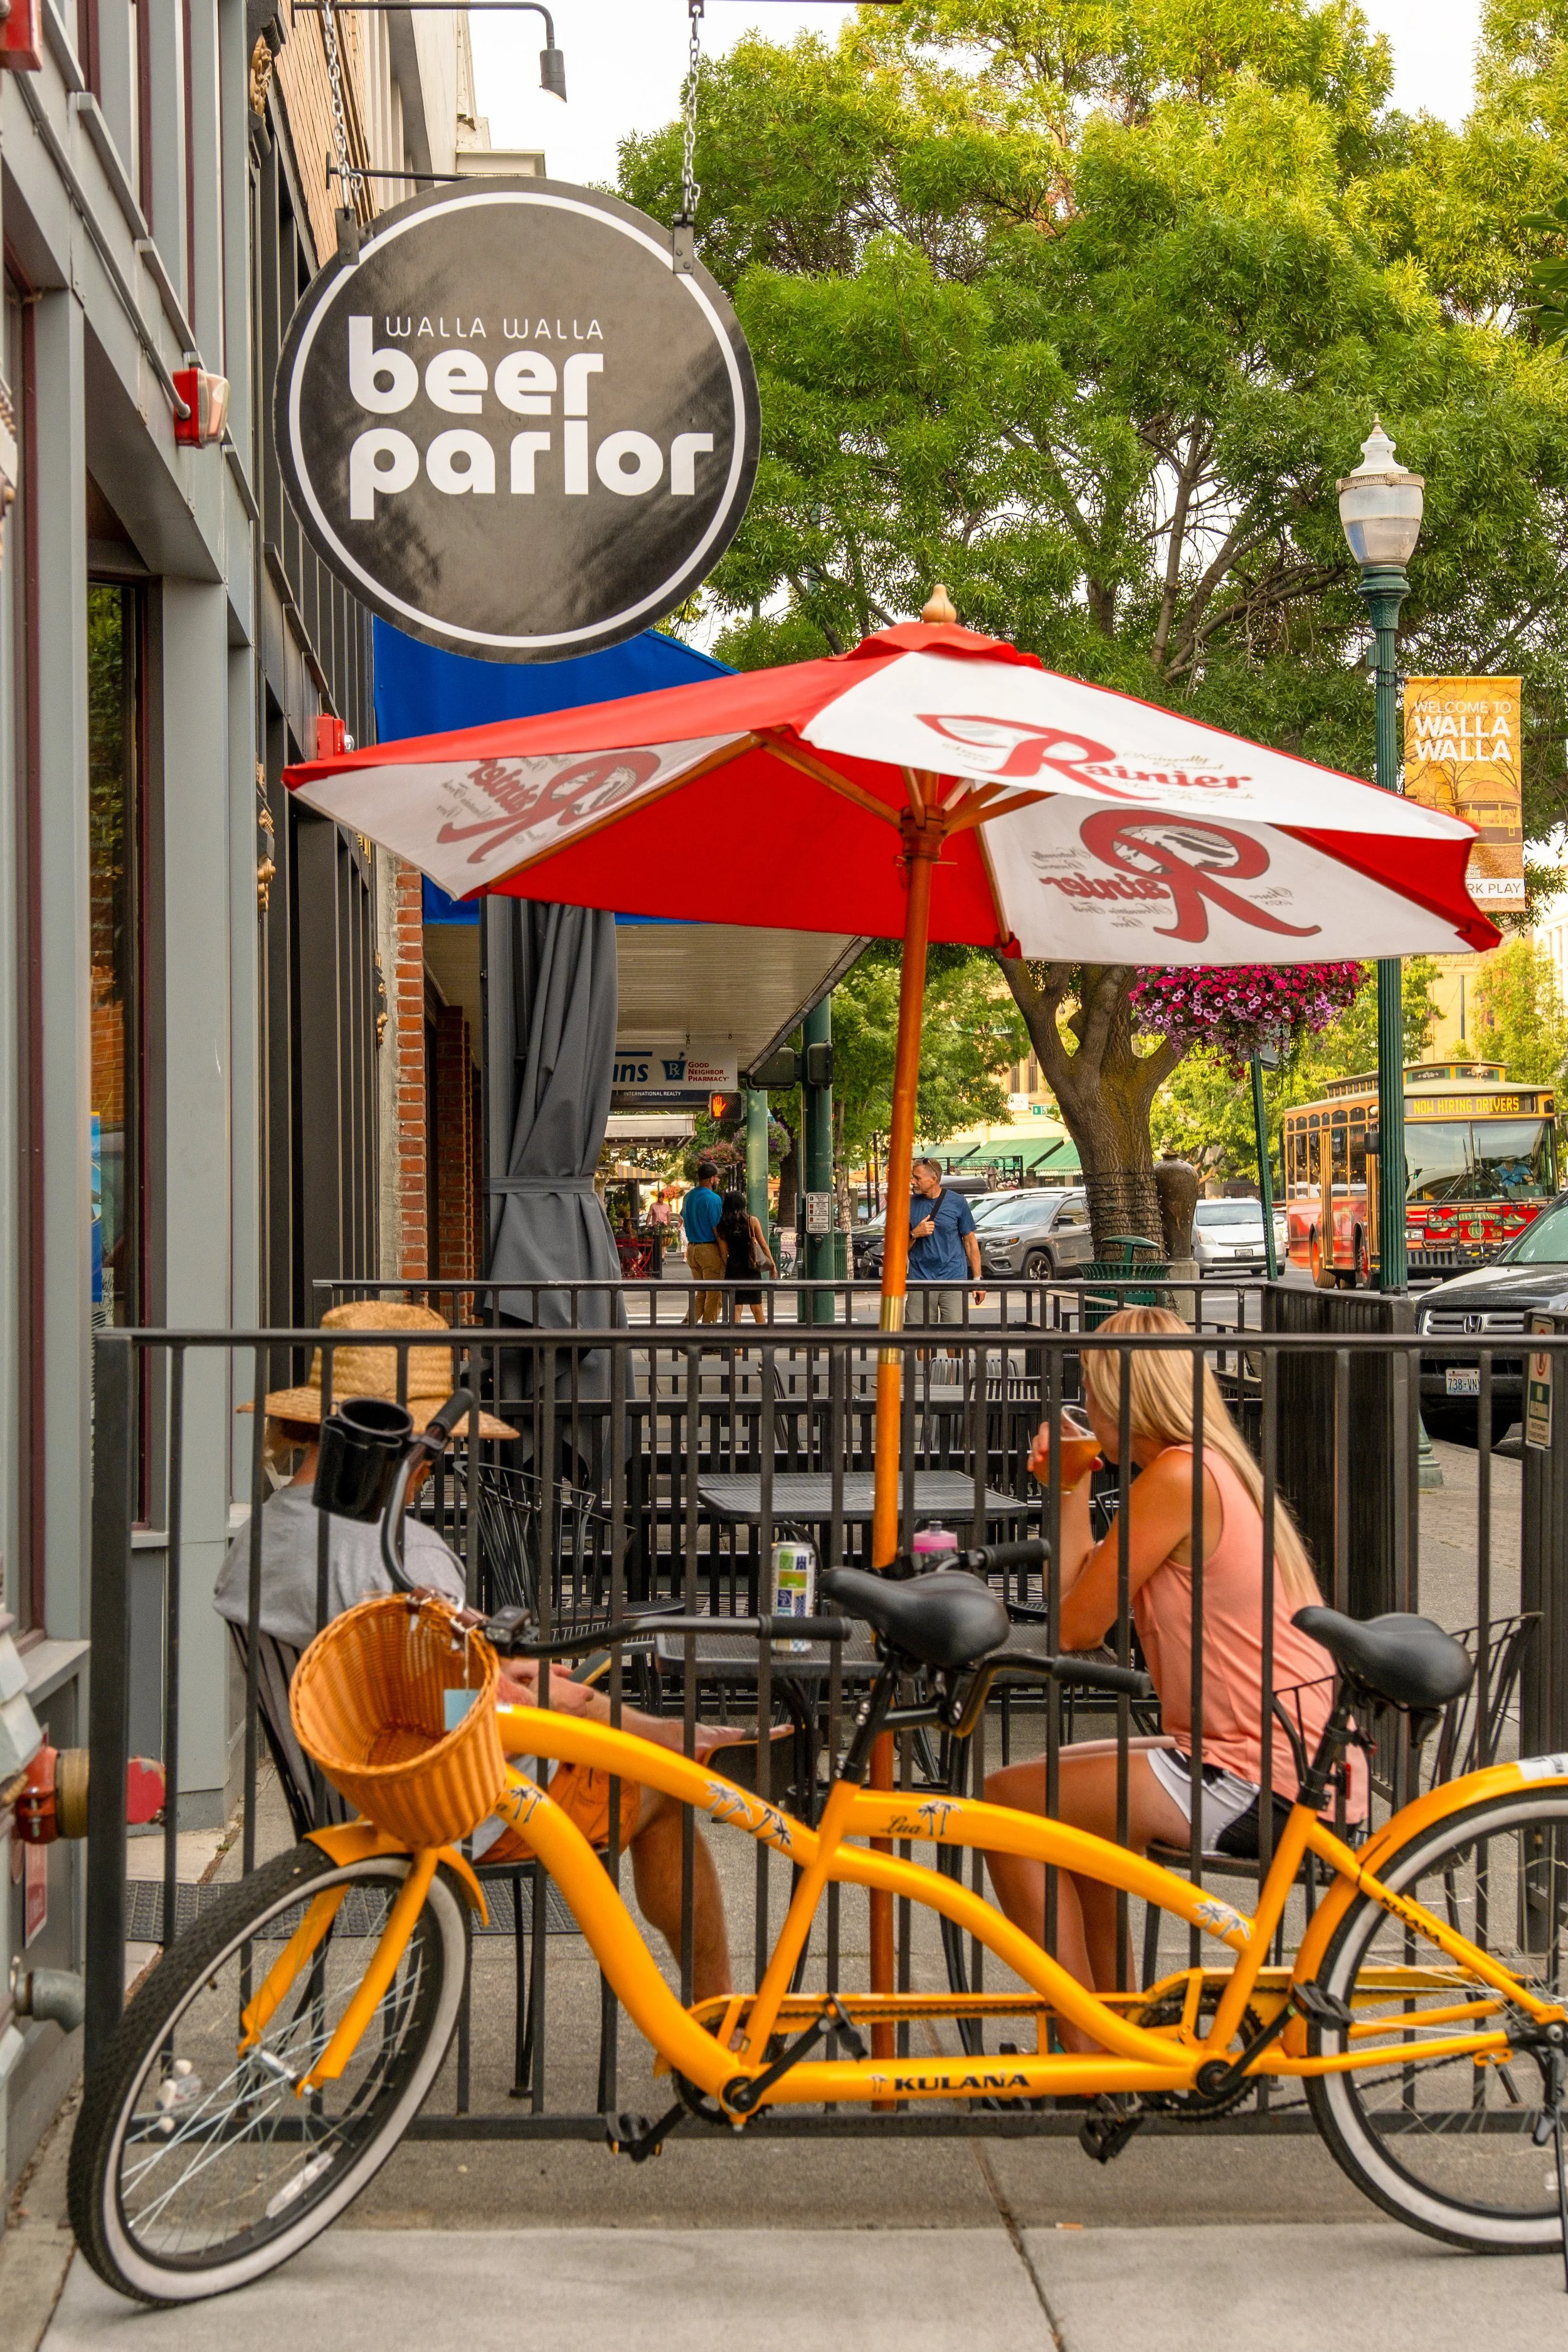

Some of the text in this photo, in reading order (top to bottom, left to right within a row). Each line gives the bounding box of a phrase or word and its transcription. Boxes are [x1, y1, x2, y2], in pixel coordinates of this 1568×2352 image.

[386, 317, 604, 341] WALLA WALLA
[348, 315, 604, 416] beer
[349, 420, 714, 521] parlor
[1414, 701, 1512, 714] WELCOME TO
[1414, 715, 1511, 738] WALLA
[914, 713, 1253, 801] Rainier
[1415, 739, 1512, 762] WALLA
[1488, 882, 1521, 894] PLAY
[1412, 1097, 1520, 1114] NOW HIRING DRIVERS
[880, 1814, 924, 1835] Lua
[1380, 1896, 1441, 1943] KULANA
[894, 2074, 1030, 2090] KULANA
